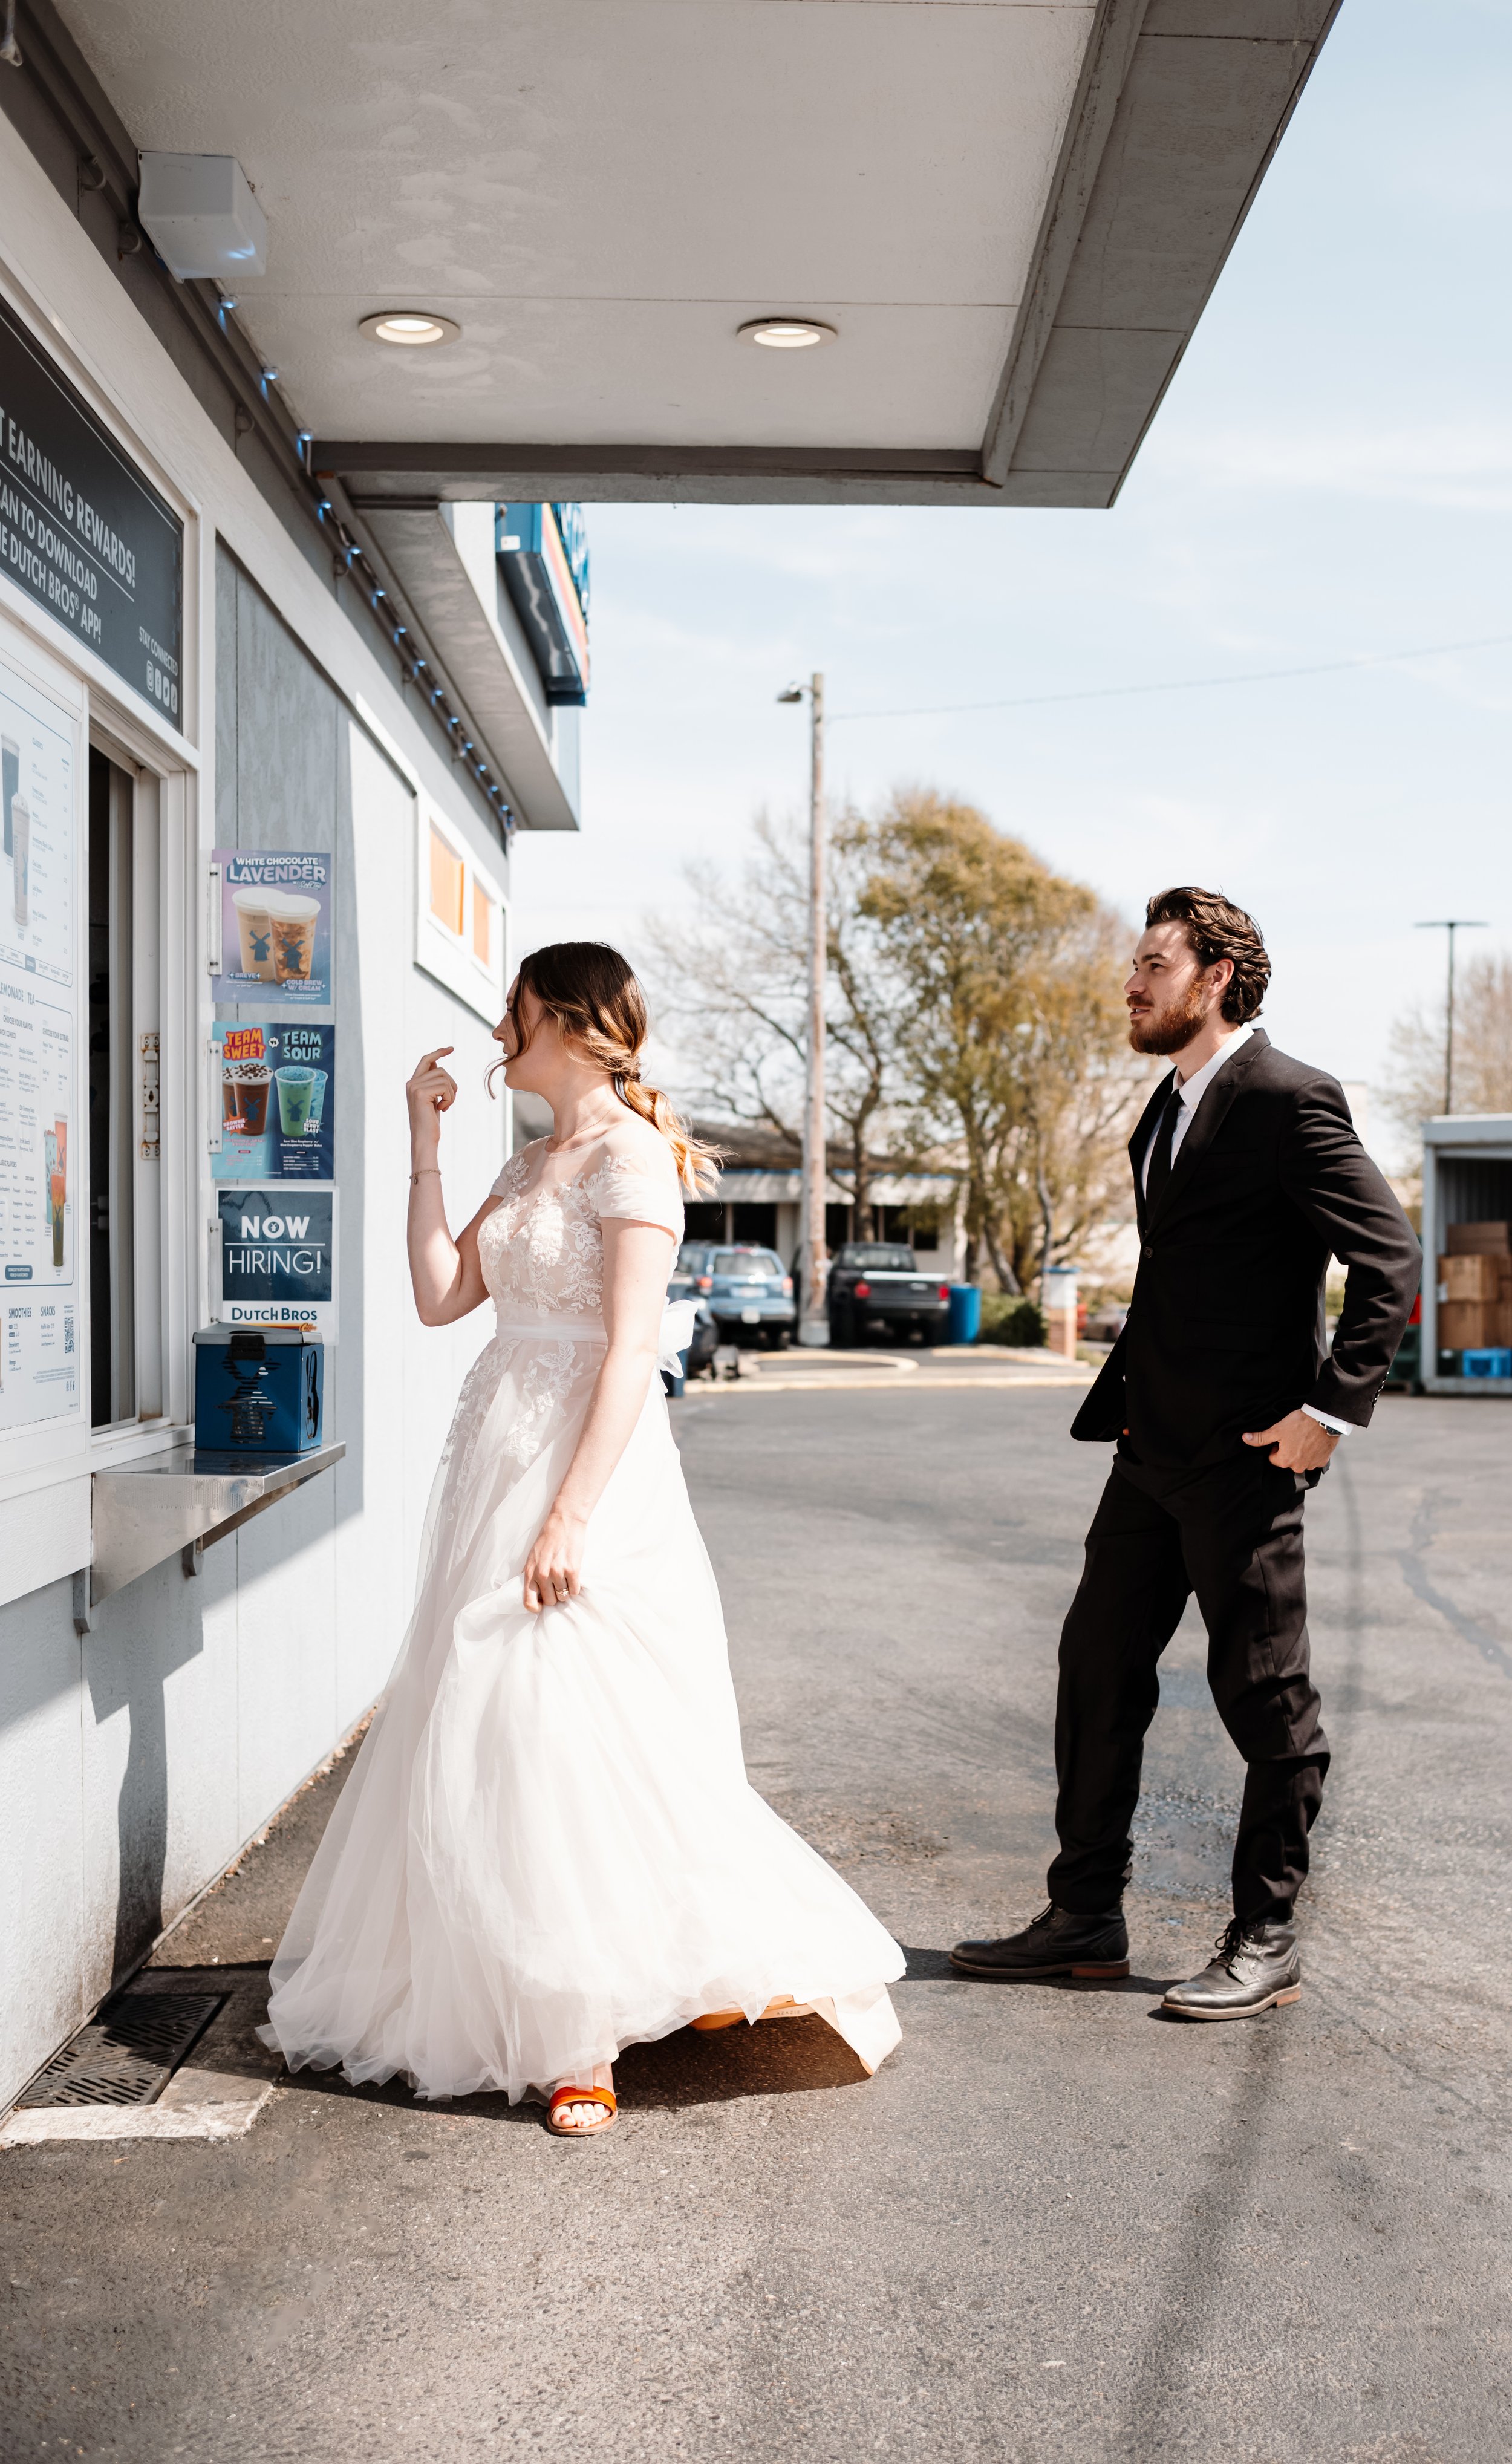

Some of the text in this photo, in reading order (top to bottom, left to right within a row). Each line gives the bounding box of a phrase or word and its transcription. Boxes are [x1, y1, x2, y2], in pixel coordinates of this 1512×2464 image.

[9, 417, 74, 520] EARNING
[77, 493, 135, 589] REWARDS!
[0, 478, 97, 601] AN TO DOWNLOAD
[10, 532, 47, 593] DUTCH
[80, 604, 102, 645] APP!
[139, 625, 178, 677] STAY CONNECTED
[236, 856, 318, 865] WHITE CHOCOLATE
[229, 865, 327, 882] LAVENDER
[27, 992, 36, 1006] TEA
[226, 1029, 262, 1046] TEAM
[282, 1031, 322, 1045] TEAM
[224, 1043, 321, 1061] SWEET SOUR
[241, 1216, 310, 1239] NOW
[229, 1250, 321, 1274] HIRING!
[8, 1306, 32, 1319] SMOOTHIES
[41, 1306, 56, 1317] SNACKS
